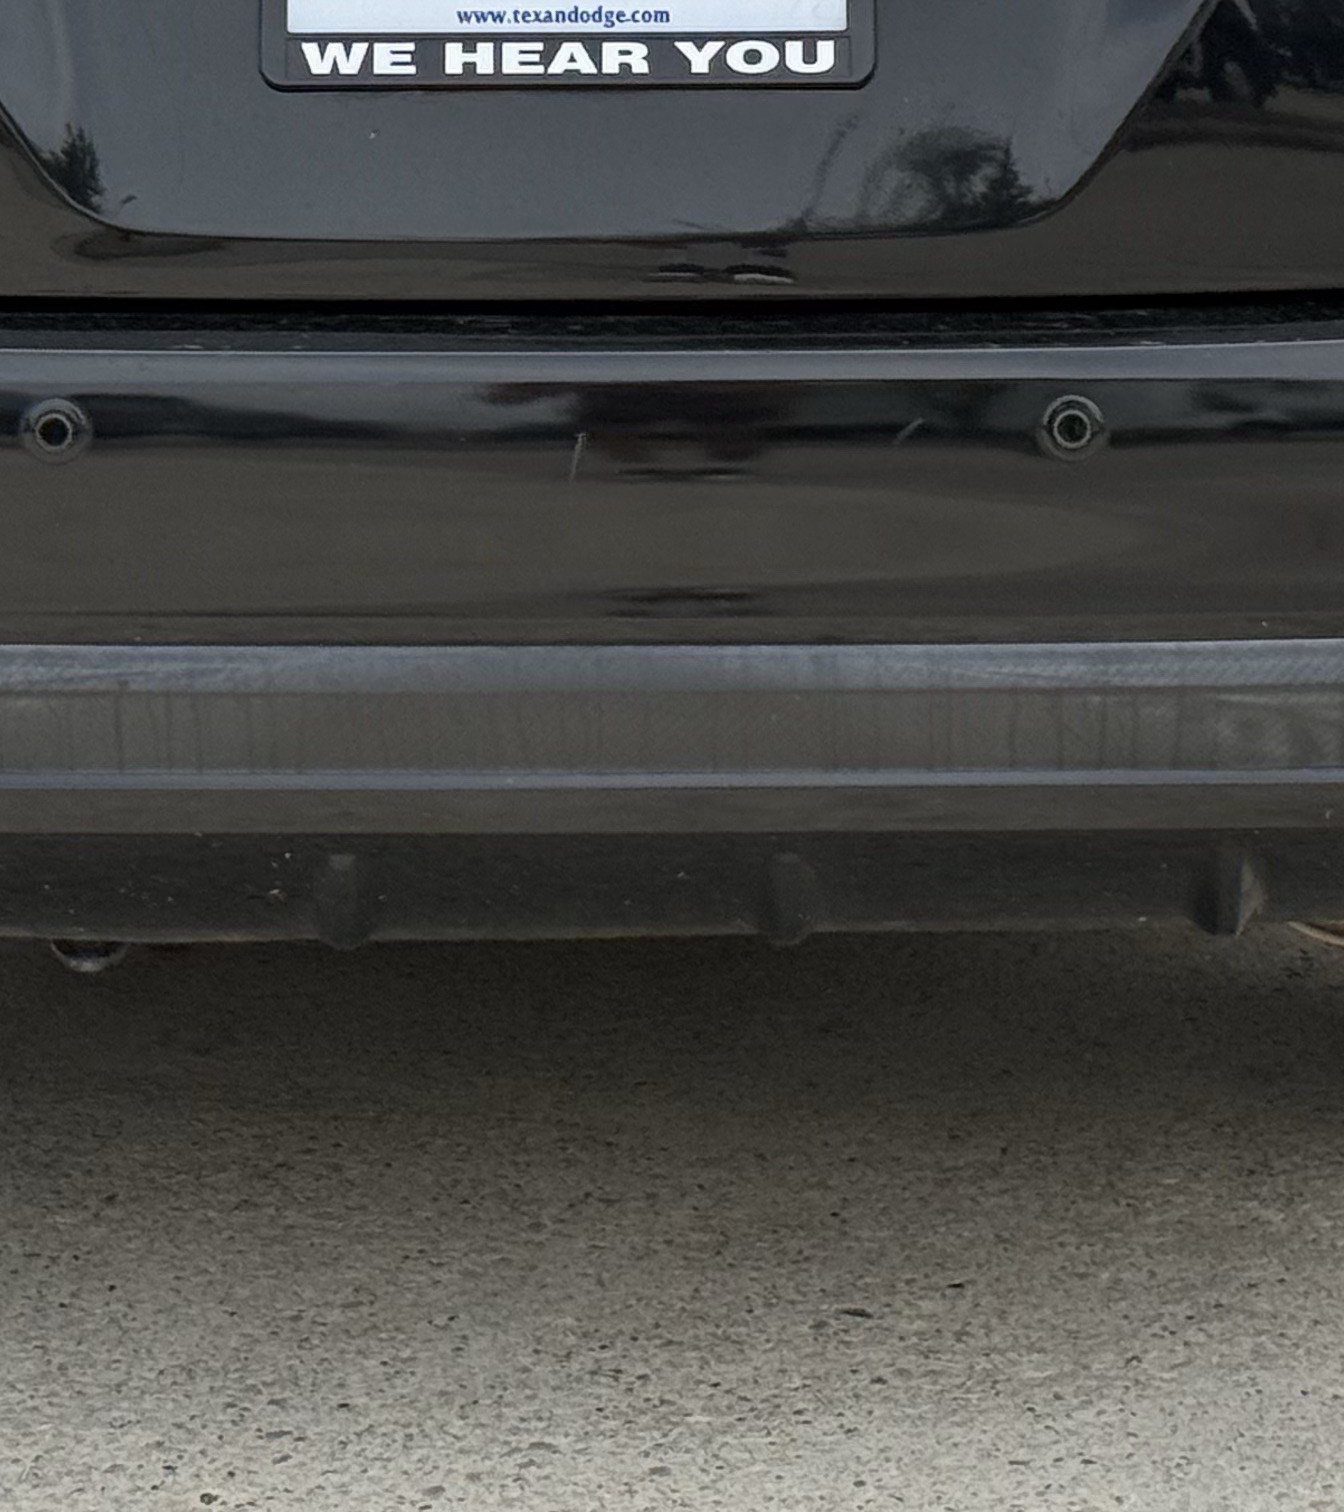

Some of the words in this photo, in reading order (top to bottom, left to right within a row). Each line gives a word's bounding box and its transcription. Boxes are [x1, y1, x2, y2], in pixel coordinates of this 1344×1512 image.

[456, 5, 671, 28] www.texandodge.com
[300, 41, 418, 76] WE
[444, 41, 651, 76] HEAR
[674, 40, 836, 75] YOU
